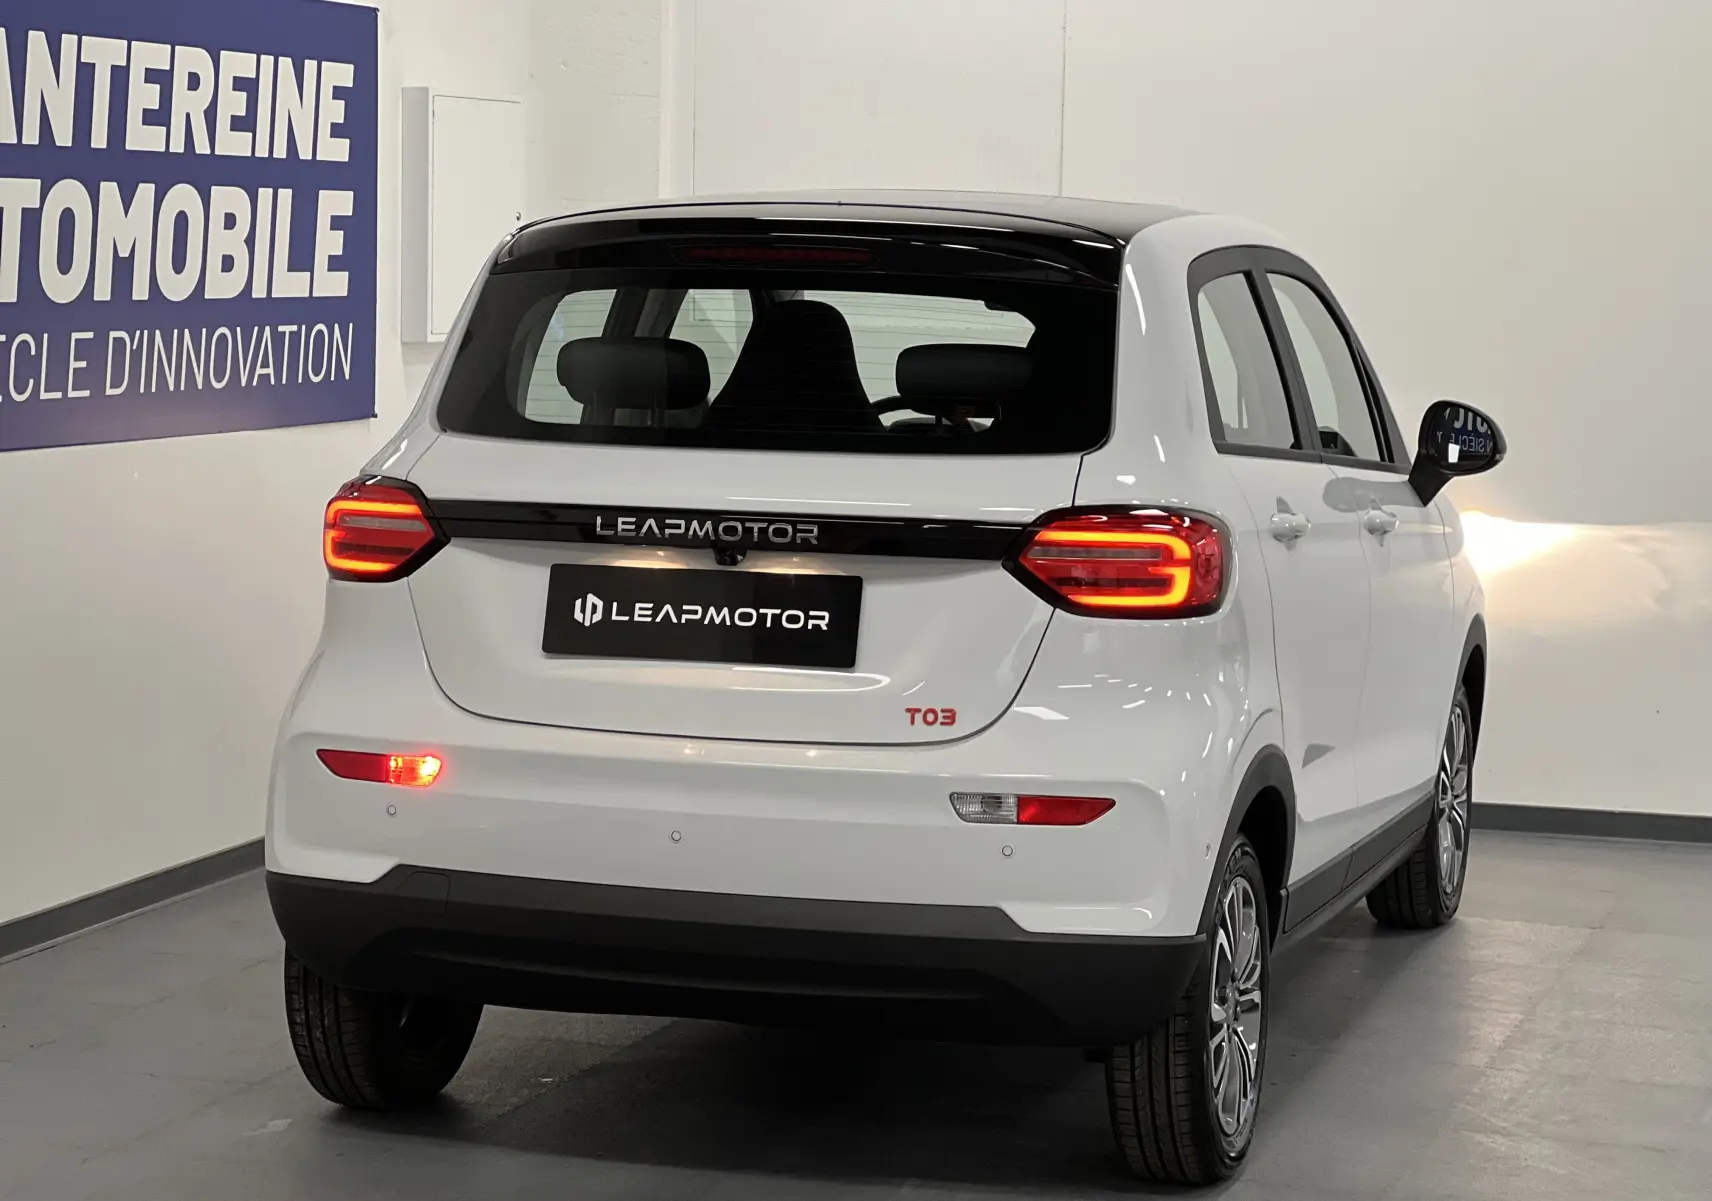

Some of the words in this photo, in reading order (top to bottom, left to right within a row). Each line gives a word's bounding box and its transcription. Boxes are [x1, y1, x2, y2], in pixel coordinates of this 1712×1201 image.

[0, 331, 94, 401] CLE
[105, 322, 353, 396] D'INNOVATION
[596, 516, 820, 545] LEAPMOTOR
[611, 601, 830, 630] LEAPMOTOR
